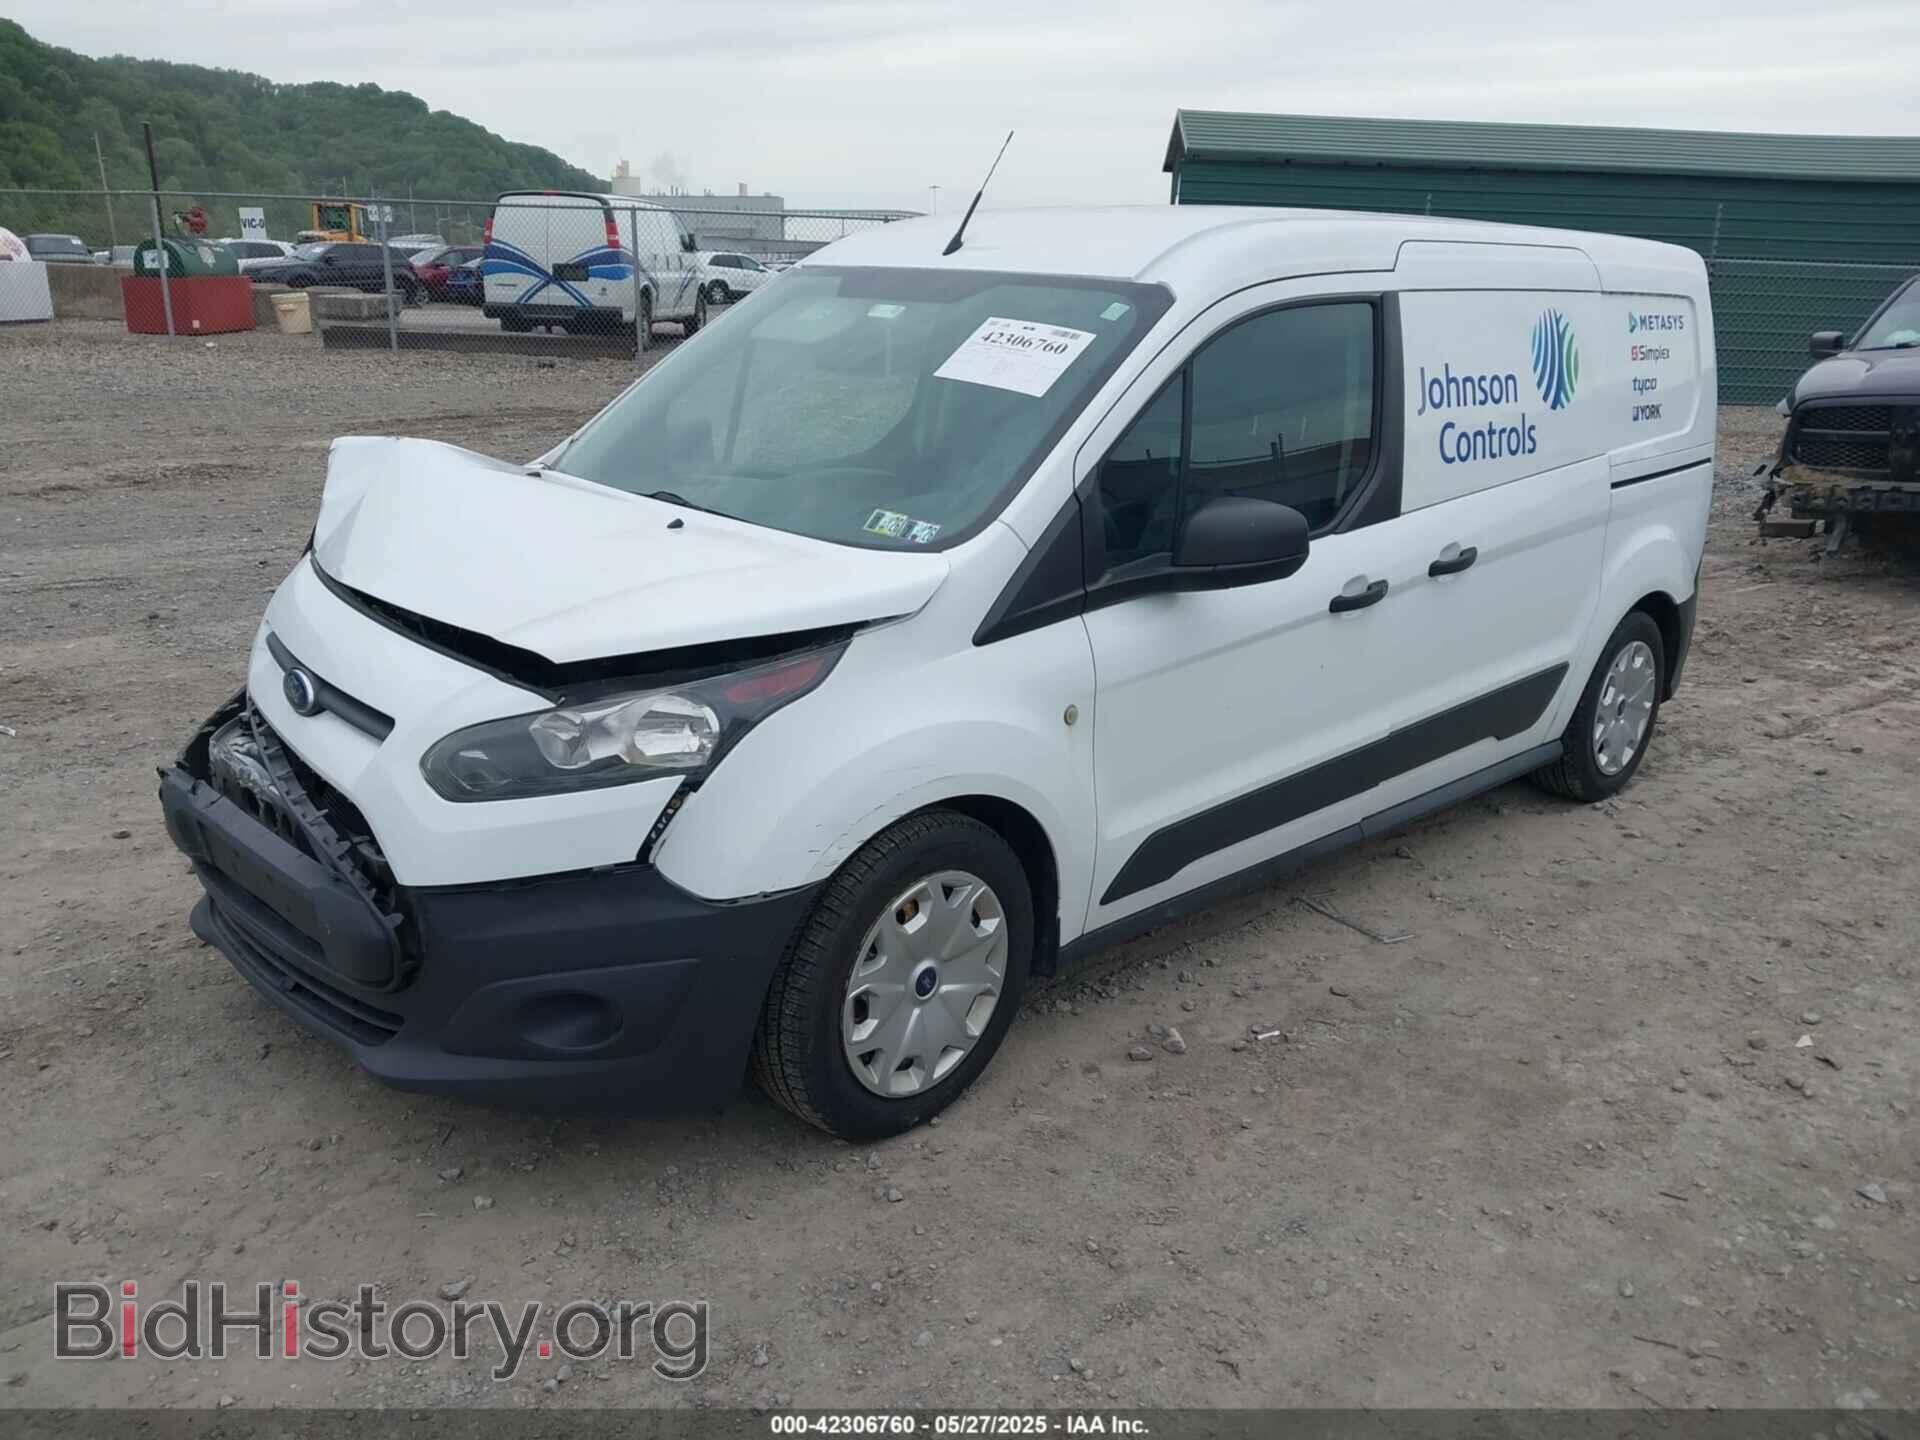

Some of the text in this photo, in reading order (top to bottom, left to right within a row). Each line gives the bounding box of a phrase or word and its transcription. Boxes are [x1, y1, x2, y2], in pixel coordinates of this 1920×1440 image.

[1640, 314, 1685, 331] METASYS
[981, 330, 1069, 355] 42306760
[1417, 362, 1518, 416] Johnson
[1632, 376, 1657, 396] tyco
[1640, 403, 1662, 421] YORK
[1439, 412, 1537, 464] Controls
